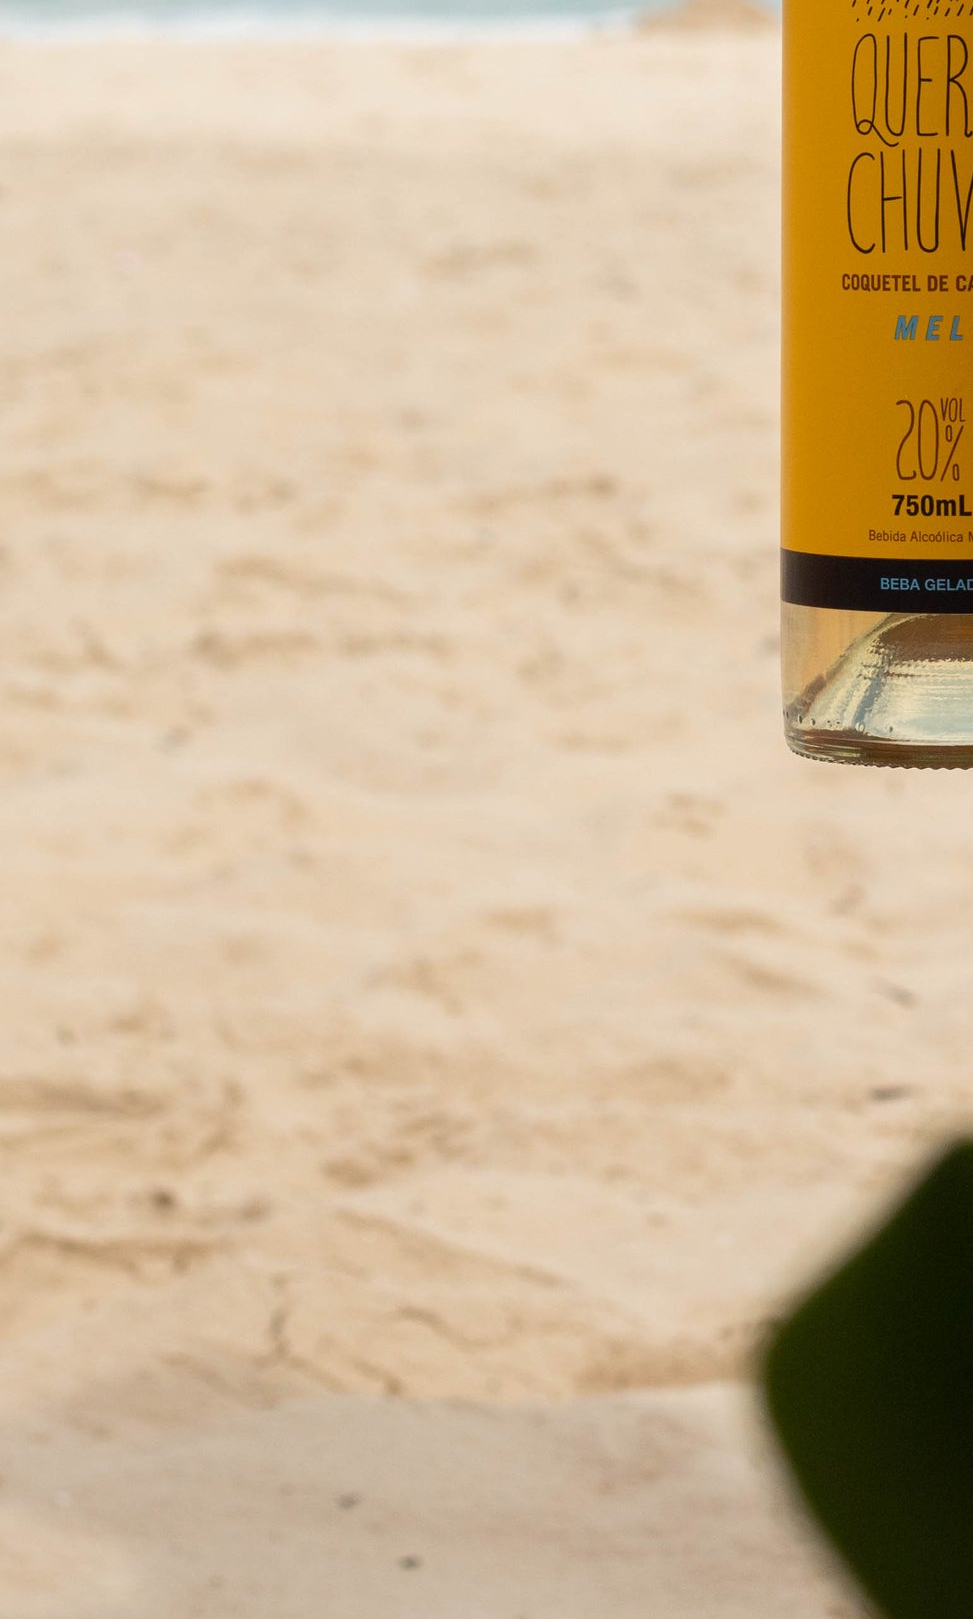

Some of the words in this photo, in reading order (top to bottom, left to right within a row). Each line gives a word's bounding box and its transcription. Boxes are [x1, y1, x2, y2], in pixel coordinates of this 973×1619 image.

[841, 273, 921, 292] COQUETEL
[927, 274, 949, 292] DE
[893, 315, 965, 341] MEL
[939, 397, 966, 423] VOL
[891, 494, 973, 517] 750mL
[868, 529, 907, 543] Bebida
[909, 529, 964, 543] Alcoólica
[880, 577, 920, 591] BEBA
